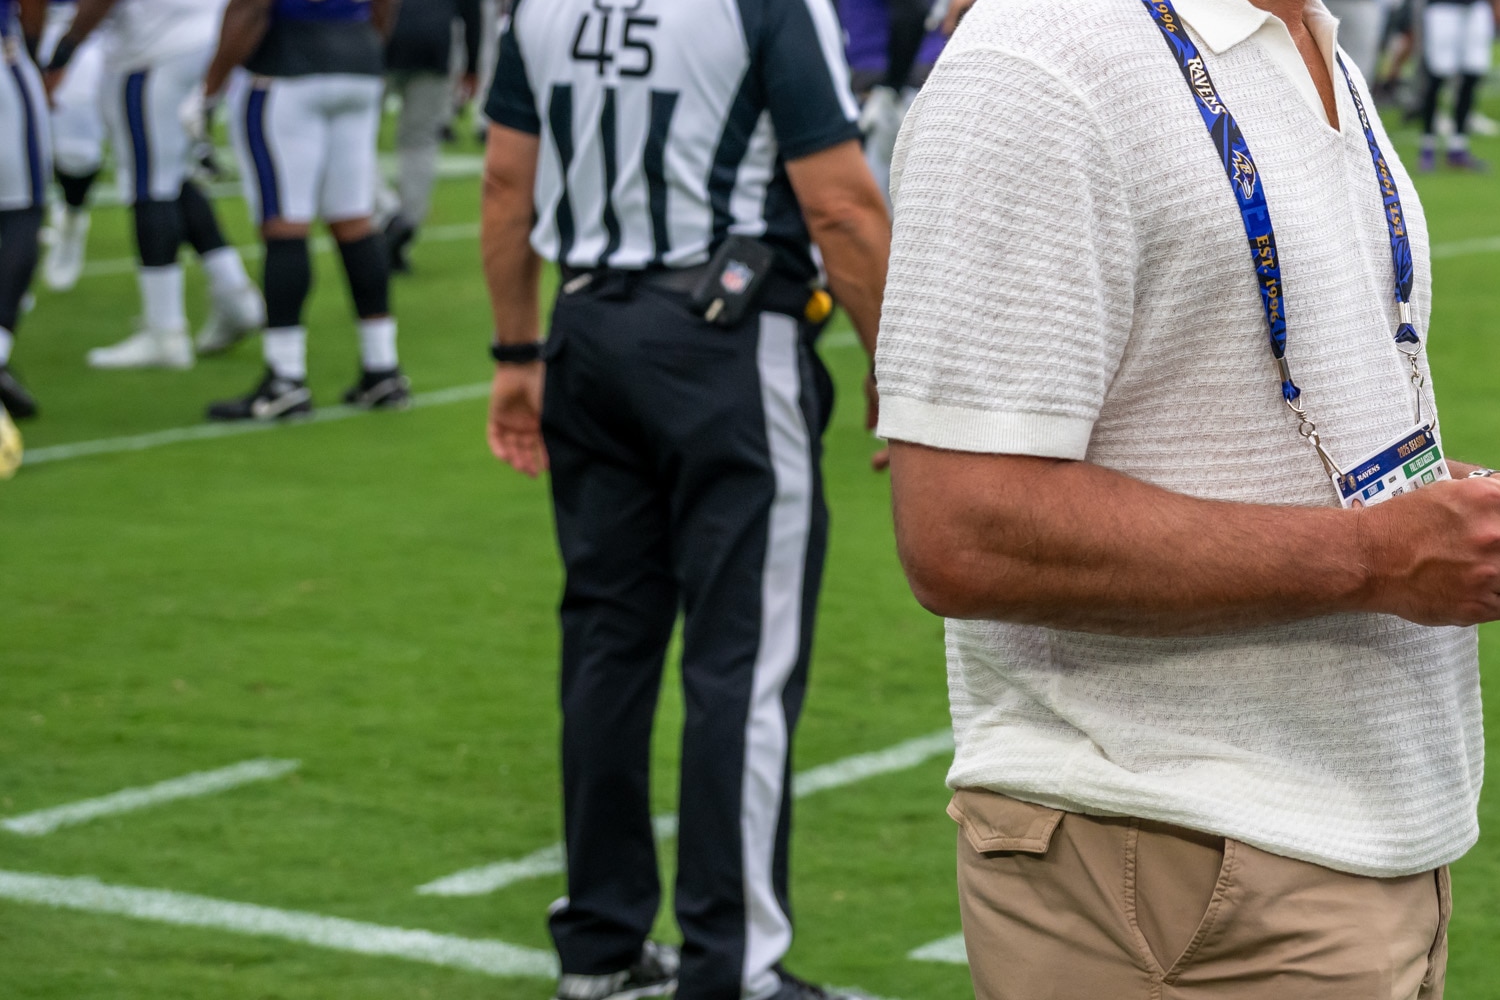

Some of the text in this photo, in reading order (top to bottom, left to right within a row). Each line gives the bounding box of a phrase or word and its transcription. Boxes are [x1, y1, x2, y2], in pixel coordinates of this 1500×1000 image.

[569, 11, 658, 78] 45
[1188, 55, 1229, 115] RAVENS
[1255, 234, 1280, 324] EST. 1996
[1357, 465, 1380, 481] RAVENS
